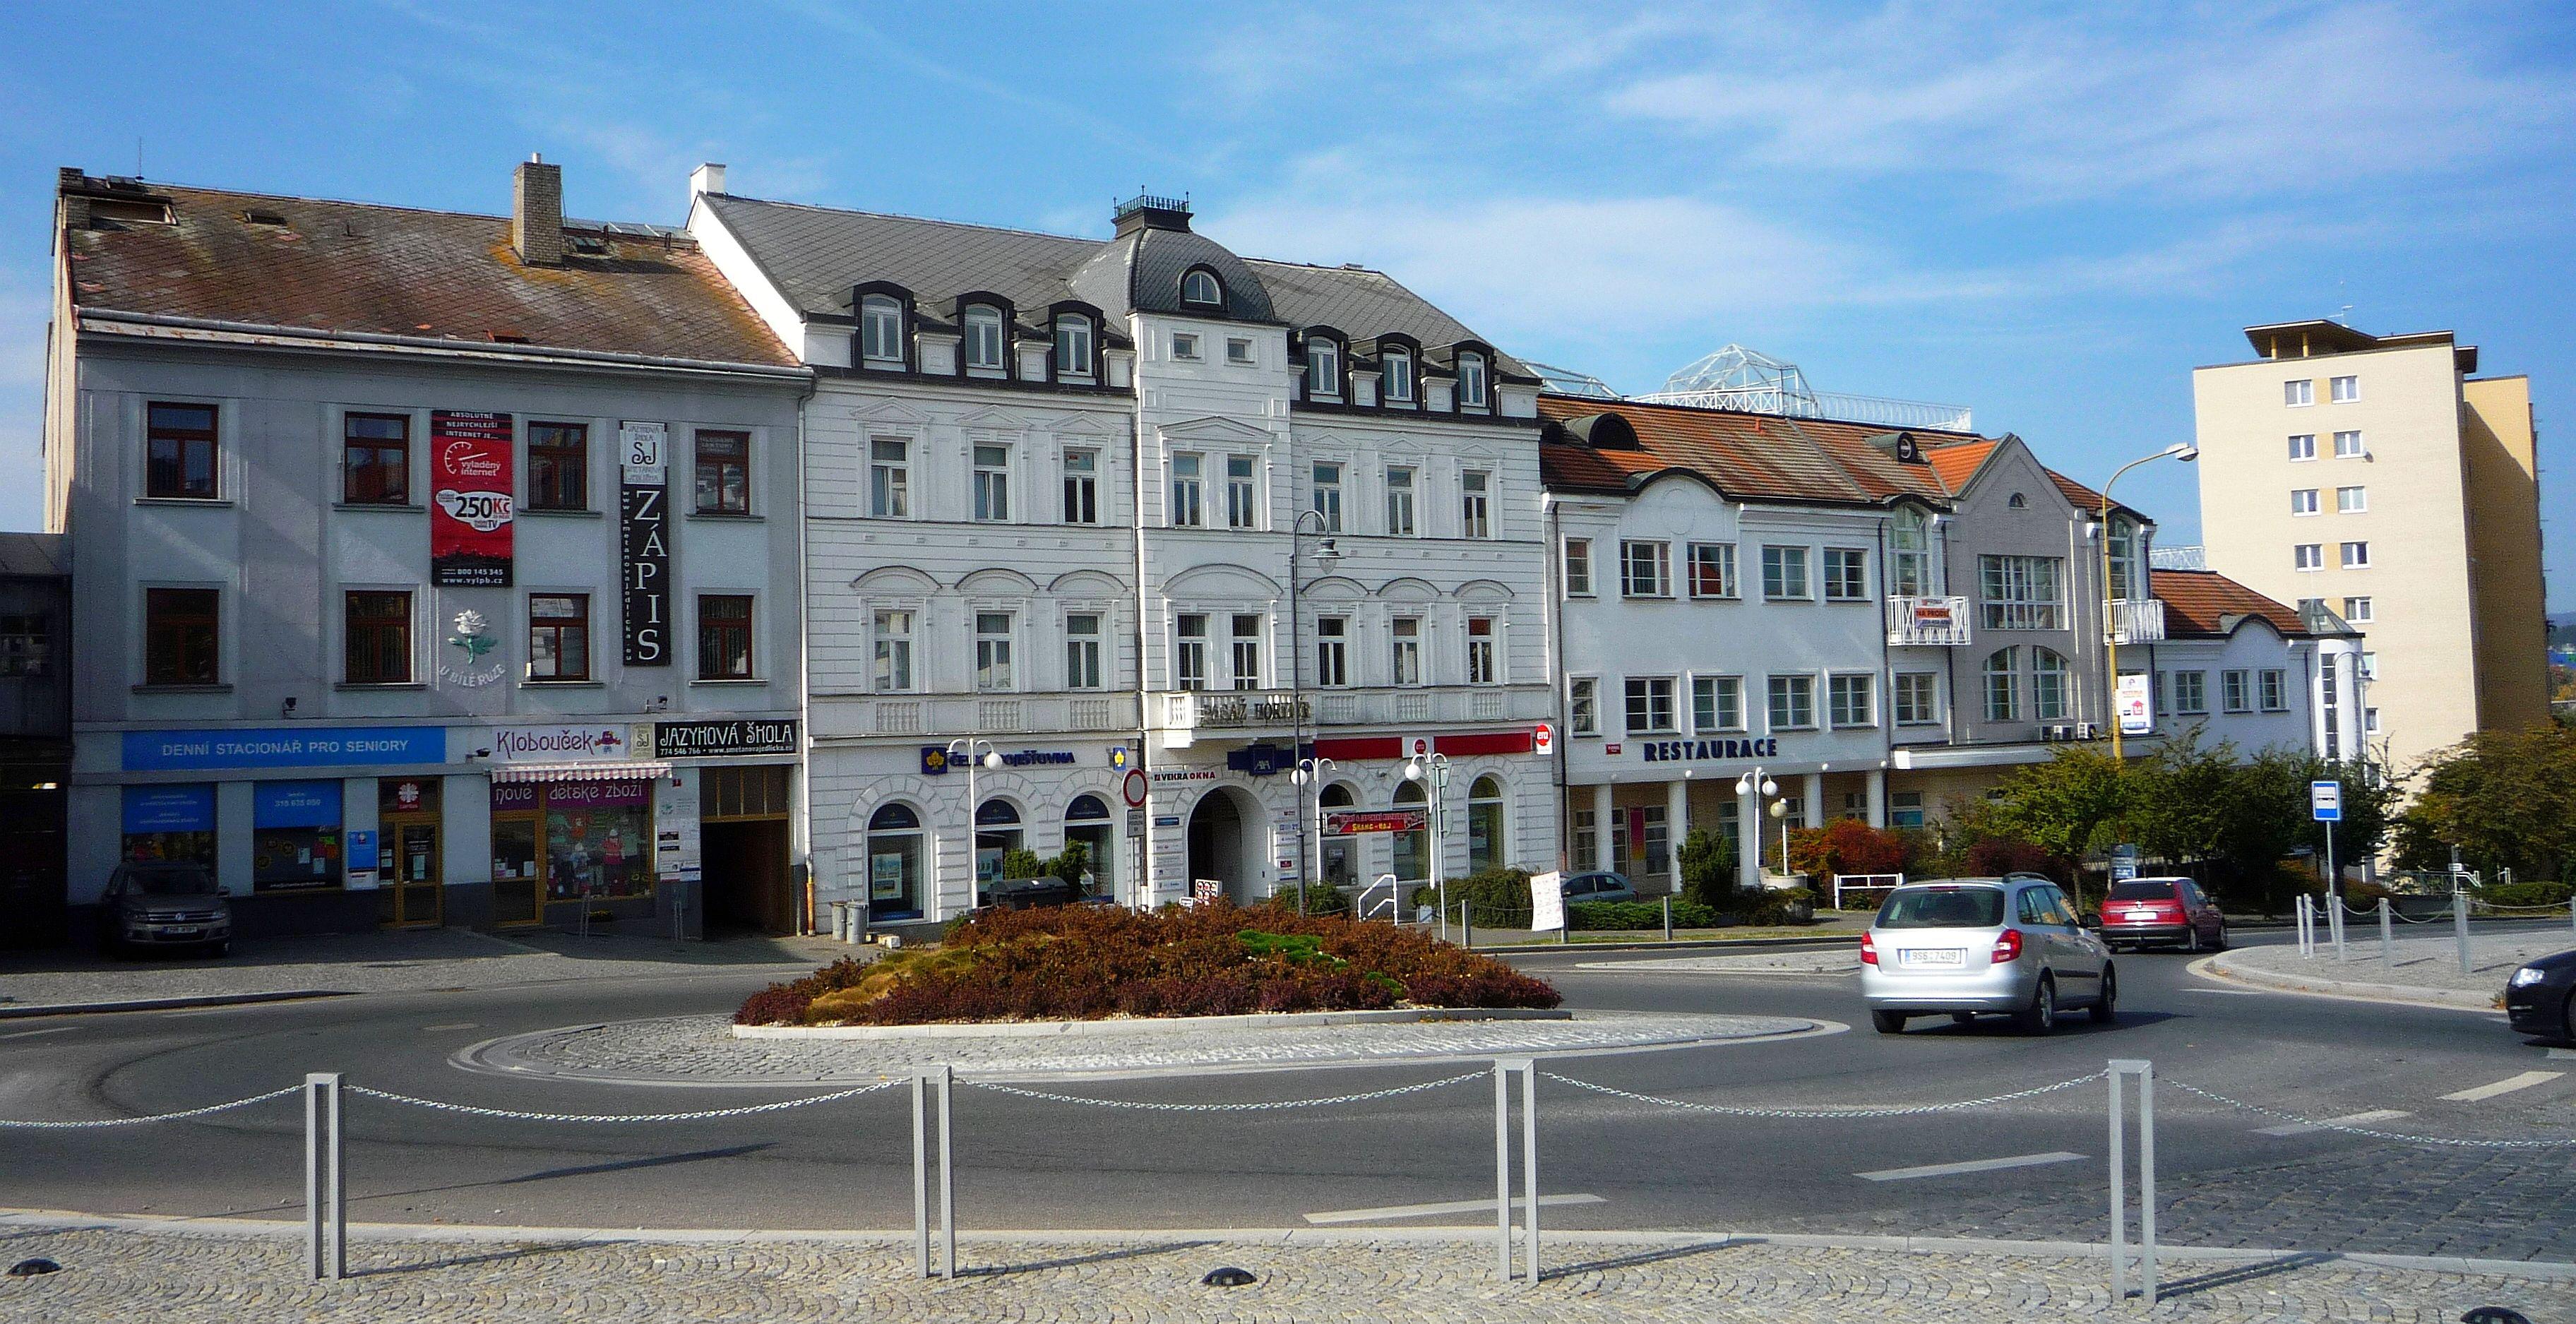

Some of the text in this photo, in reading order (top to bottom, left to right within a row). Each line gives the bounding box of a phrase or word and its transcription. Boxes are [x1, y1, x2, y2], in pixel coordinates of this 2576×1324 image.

[455, 496, 493, 518] 250
[493, 497, 511, 513] Kč
[487, 520, 498, 528] TV
[634, 490, 667, 660] ZÁPIS
[439, 665, 451, 676] U
[496, 729, 595, 760] Klobouček
[660, 722, 793, 746] JAZYKOVÁ ŠKOLA
[162, 739, 409, 756] DENNÍ STACIONÁŘ PRO SENIORY
[1644, 739, 1777, 762] RESTAURACE
[1161, 771, 1215, 781] VEKRA OKNA
[495, 780, 643, 805] nové dětské zboží
[1934, 951, 1956, 960] 7409
